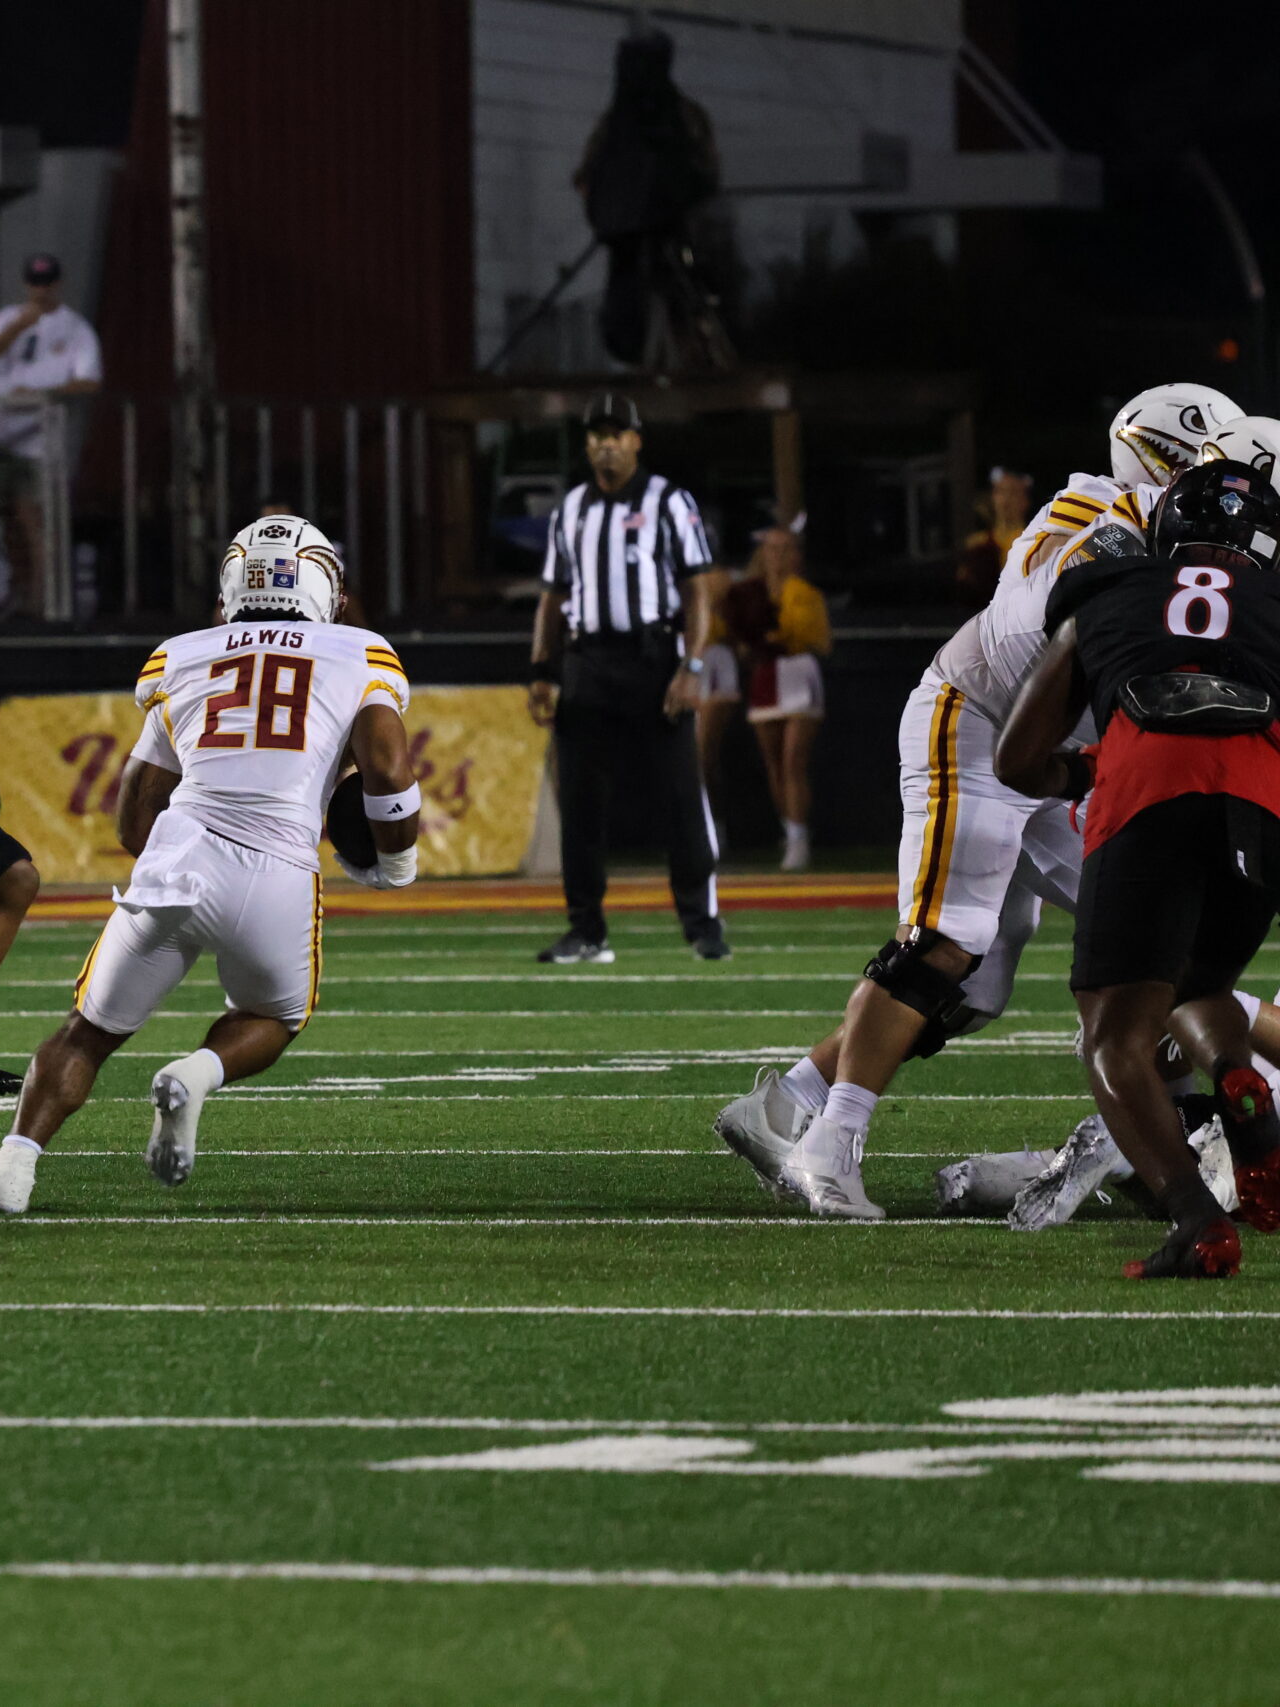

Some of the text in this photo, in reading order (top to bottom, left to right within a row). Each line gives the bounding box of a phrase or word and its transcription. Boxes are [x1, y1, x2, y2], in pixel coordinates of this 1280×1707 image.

[247, 570, 266, 589] 28
[240, 595, 301, 606] WARHAWKS
[1161, 564, 1235, 640] 8
[226, 630, 304, 650] LEWIS
[197, 652, 315, 752] 28
